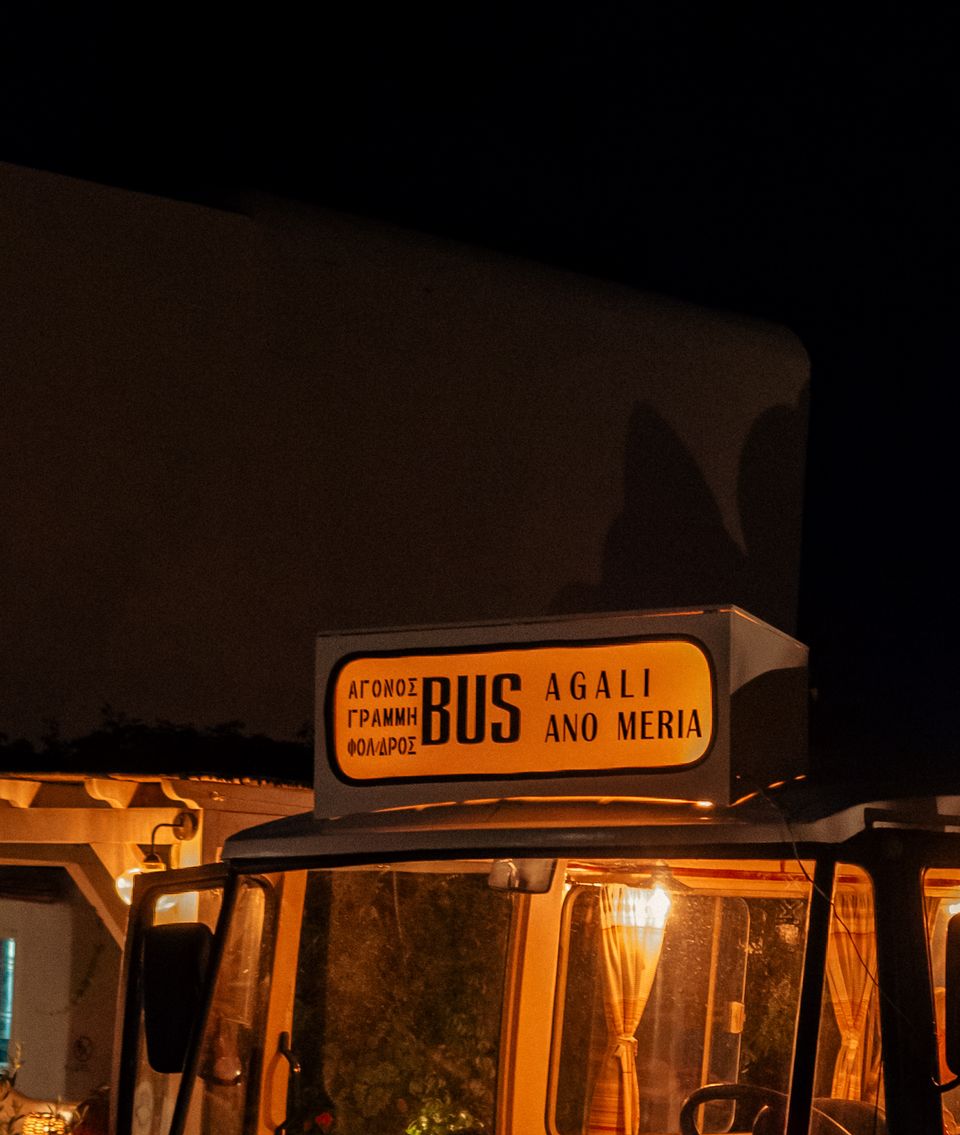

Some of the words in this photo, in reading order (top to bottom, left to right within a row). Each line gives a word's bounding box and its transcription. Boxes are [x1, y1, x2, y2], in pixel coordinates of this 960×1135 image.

[348, 678, 417, 699] ΑΓΟΝΟΣ
[545, 668, 650, 701] AGALI
[348, 707, 417, 728] ΓΡΑΜΜΗ
[421, 673, 522, 746] BUS
[544, 712, 598, 743] ANO
[617, 709, 702, 741] MERIA
